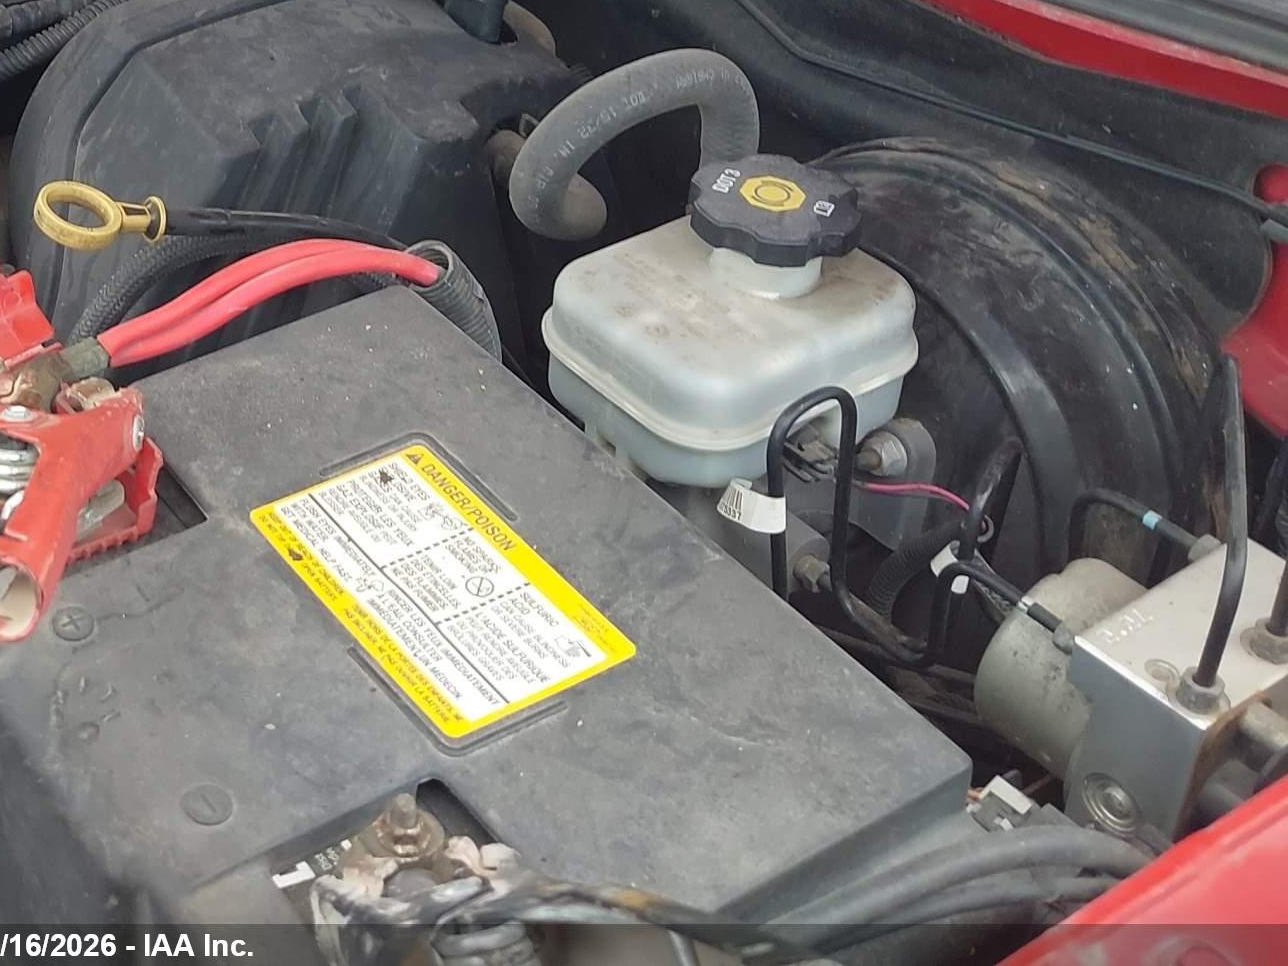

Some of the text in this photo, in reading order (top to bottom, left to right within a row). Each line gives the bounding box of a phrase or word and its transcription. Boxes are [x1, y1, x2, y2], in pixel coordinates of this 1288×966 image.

[409, 483, 431, 500] EYES
[419, 464, 517, 550] DANGER/POISON
[316, 517, 337, 535] EYES
[378, 514, 396, 527] LES
[392, 527, 414, 546] YEUX
[508, 596, 531, 615] ACID
[518, 591, 559, 627] SULFURIC
[408, 613, 426, 627] LES
[421, 628, 445, 647] YEUX
[501, 638, 551, 683] SULFURIQUE
